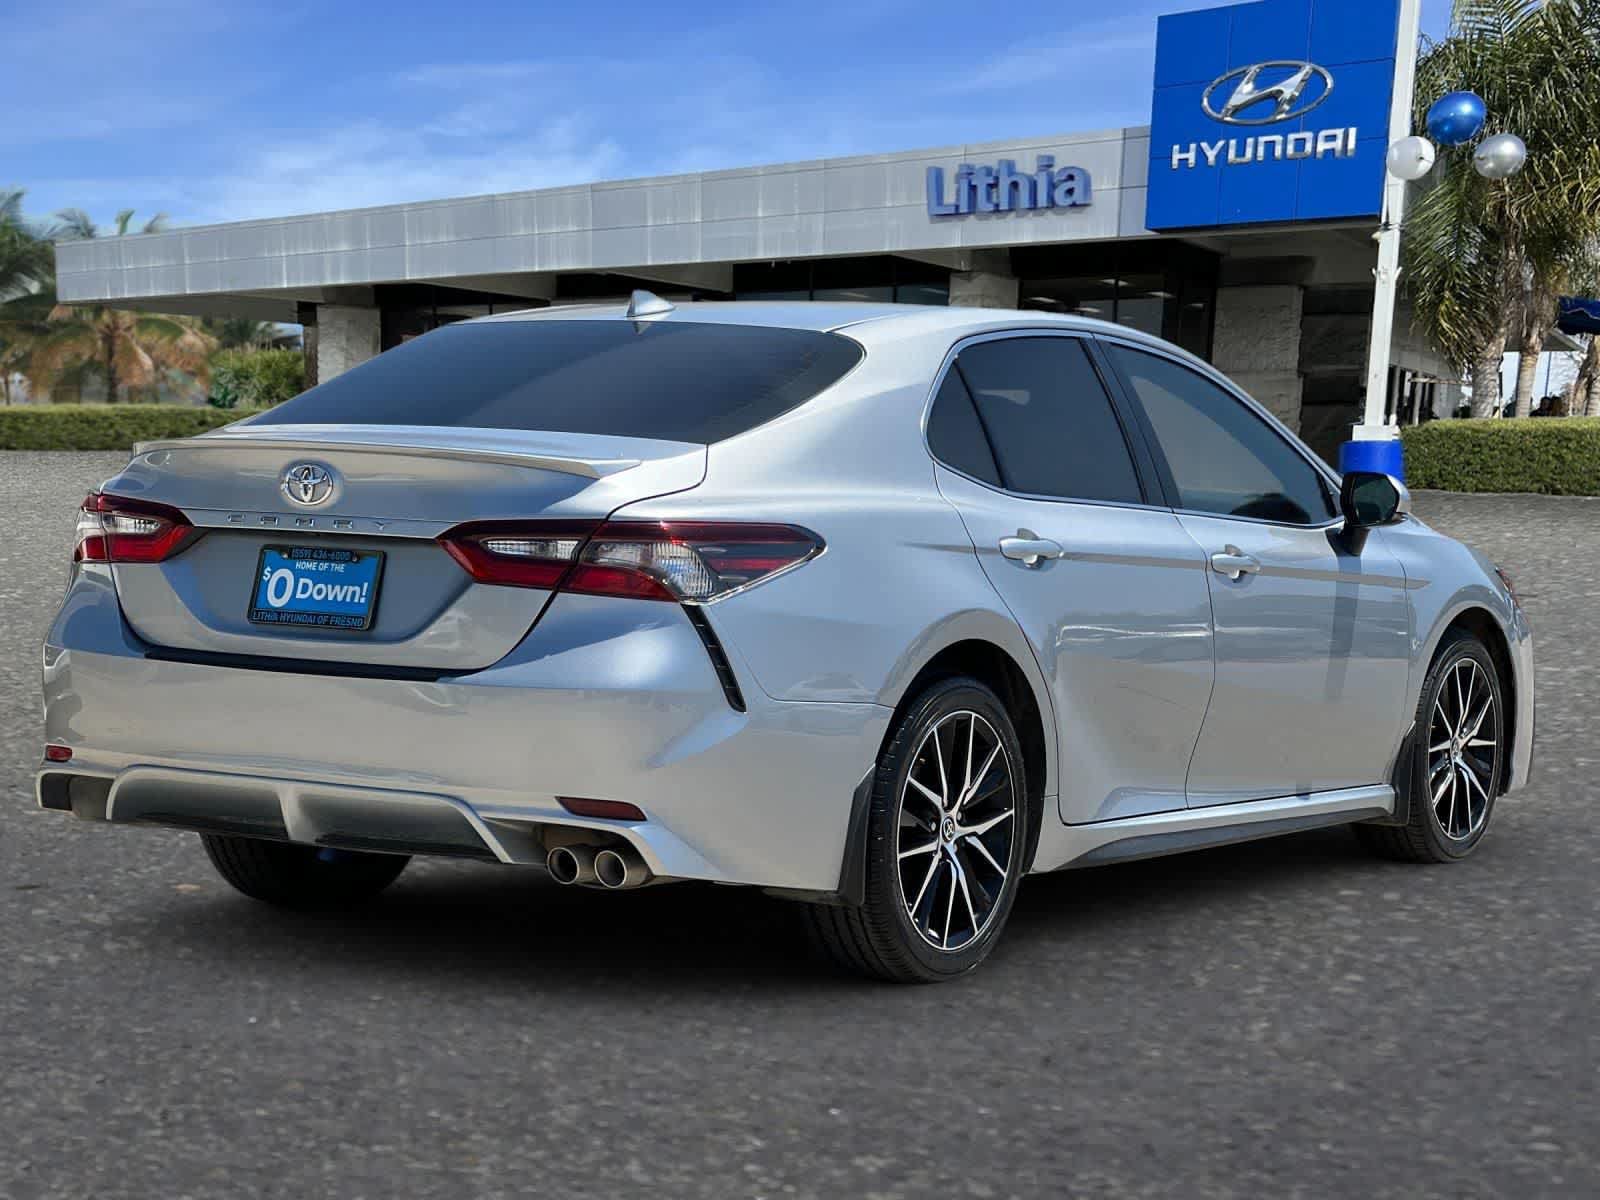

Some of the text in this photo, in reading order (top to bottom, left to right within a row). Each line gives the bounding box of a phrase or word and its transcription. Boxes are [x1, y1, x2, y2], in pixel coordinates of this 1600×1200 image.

[1171, 127, 1358, 169] HYUNDAI
[926, 155, 1092, 219] Lithia
[227, 513, 392, 531] CAMRY
[295, 560, 345, 573] HOME OF THE
[296, 577, 369, 604] Down!
[279, 611, 316, 624] HYUNDAI
[317, 615, 329, 625] OF
[329, 615, 364, 627] FRESNO
